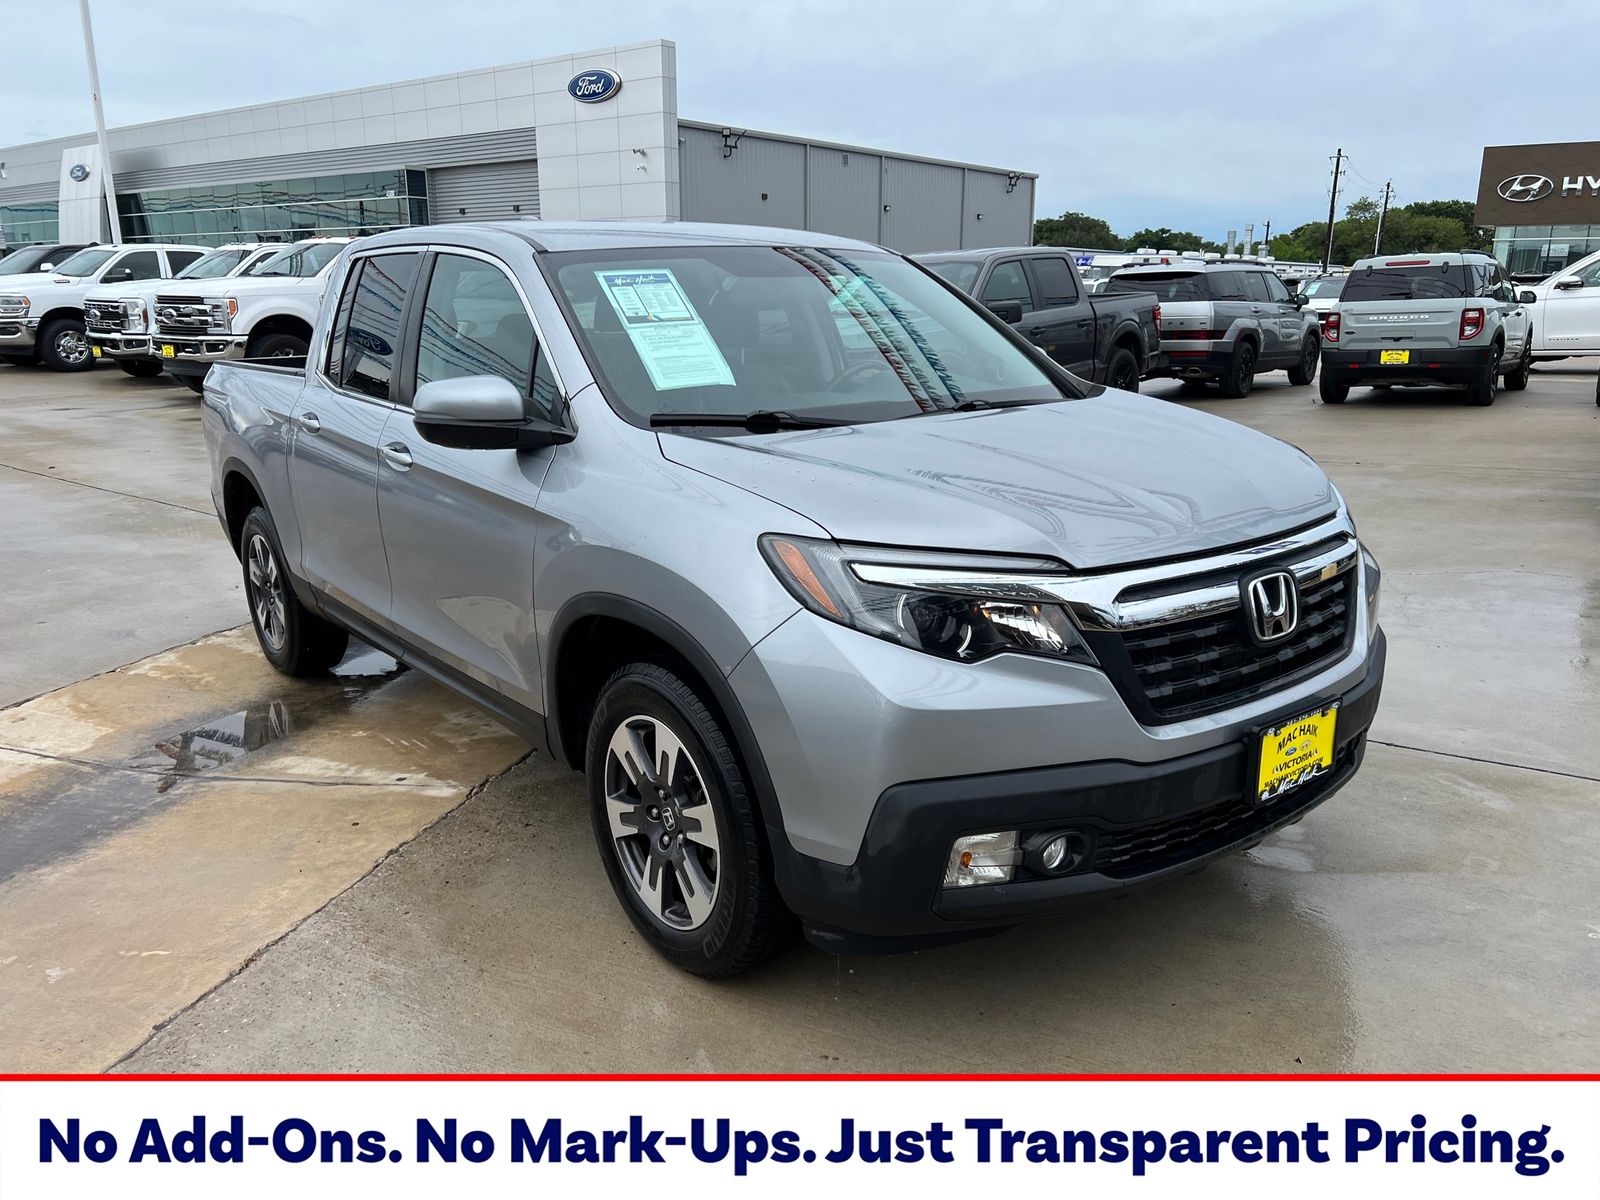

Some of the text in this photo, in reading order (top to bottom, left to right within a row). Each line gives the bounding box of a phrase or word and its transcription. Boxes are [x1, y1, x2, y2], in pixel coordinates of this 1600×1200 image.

[576, 76, 605, 96] Ford
[1277, 728, 1298, 754] MAC
[1299, 723, 1318, 737] HAIK
[1279, 750, 1312, 772] VICTORIA
[1276, 778, 1297, 795] Mac
